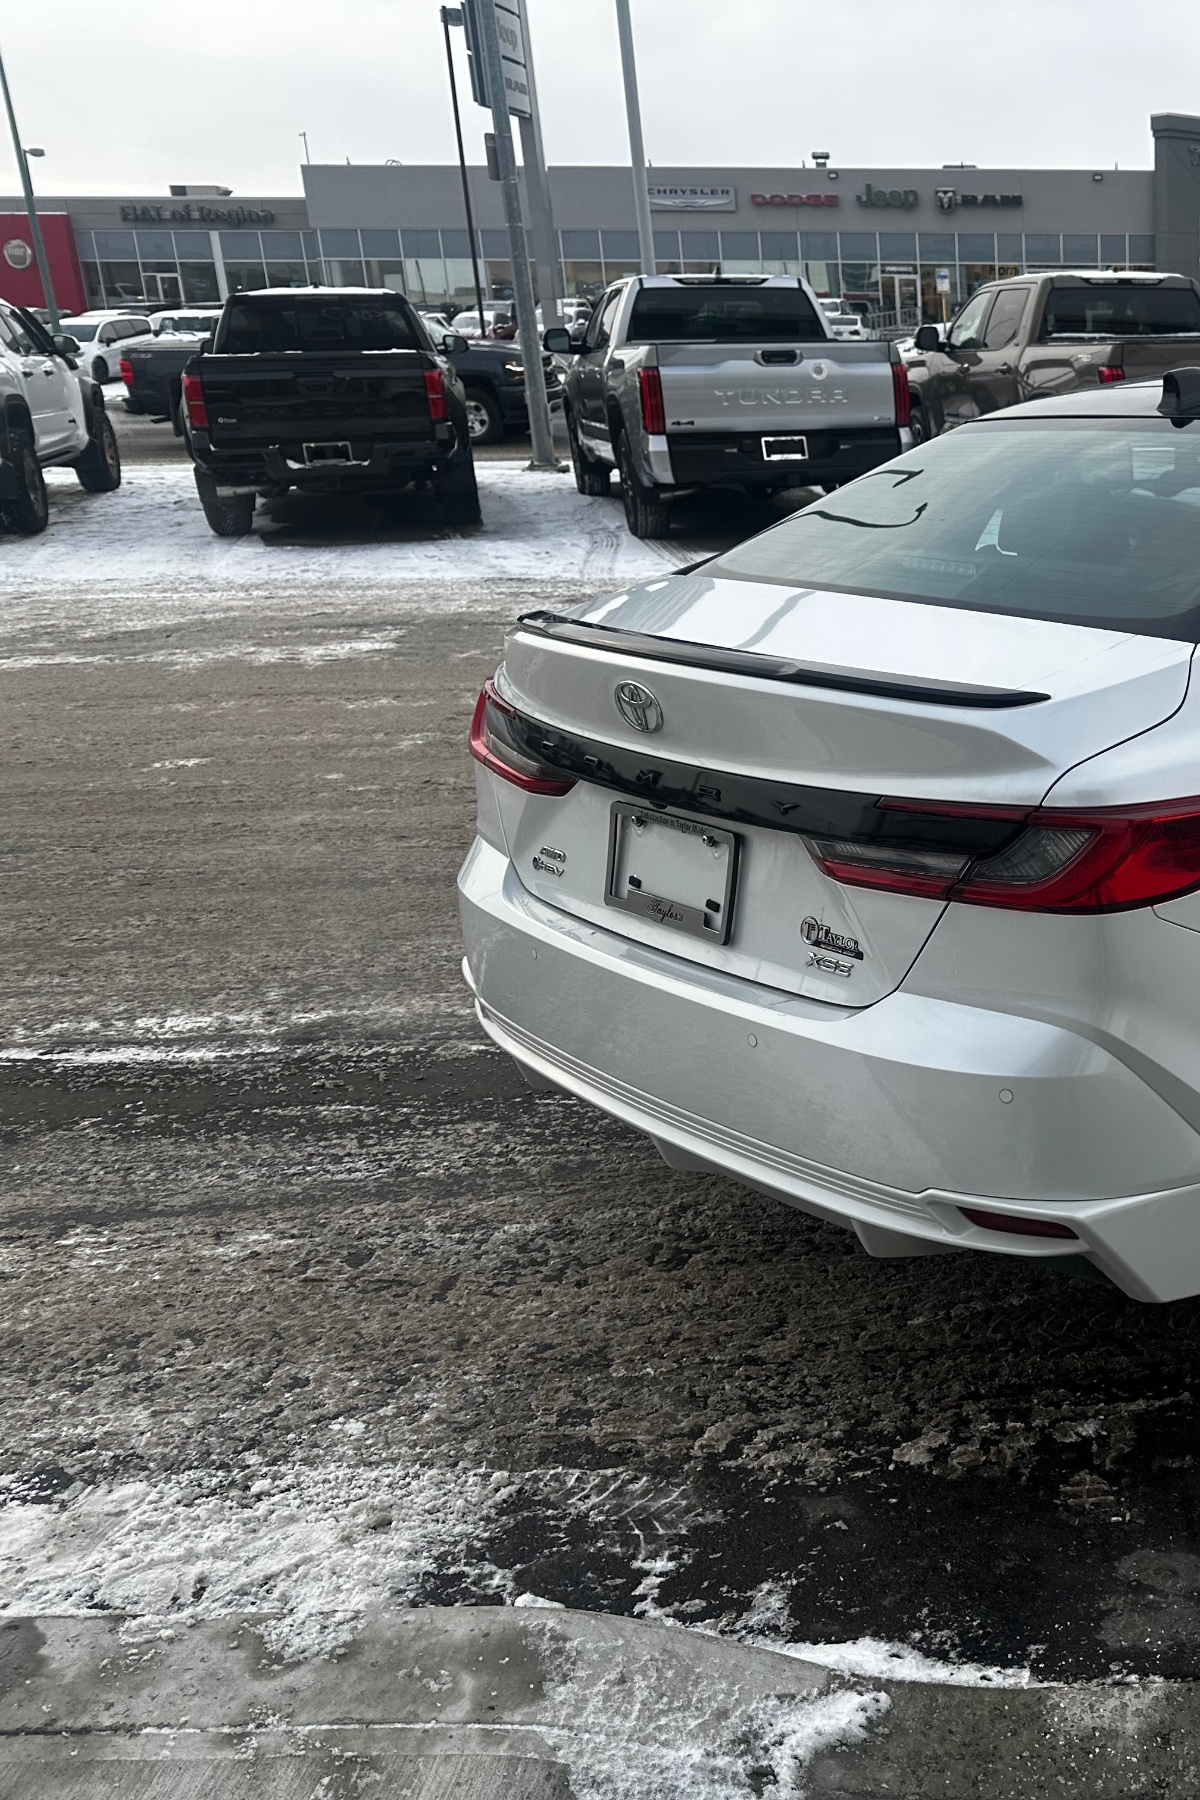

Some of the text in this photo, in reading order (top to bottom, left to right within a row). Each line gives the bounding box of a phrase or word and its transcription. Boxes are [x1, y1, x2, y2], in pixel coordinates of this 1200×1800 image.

[648, 187, 731, 196] CHRYSLER
[751, 193, 839, 206] DODGE
[856, 183, 918, 208] Jeep
[960, 194, 1023, 207] RAM
[119, 203, 275, 226] FIAT of Regina
[714, 389, 848, 406] TUNDRA
[676, 819, 692, 833] Taylor
[647, 898, 684, 922] Taylor's
[803, 951, 855, 978] XSE
